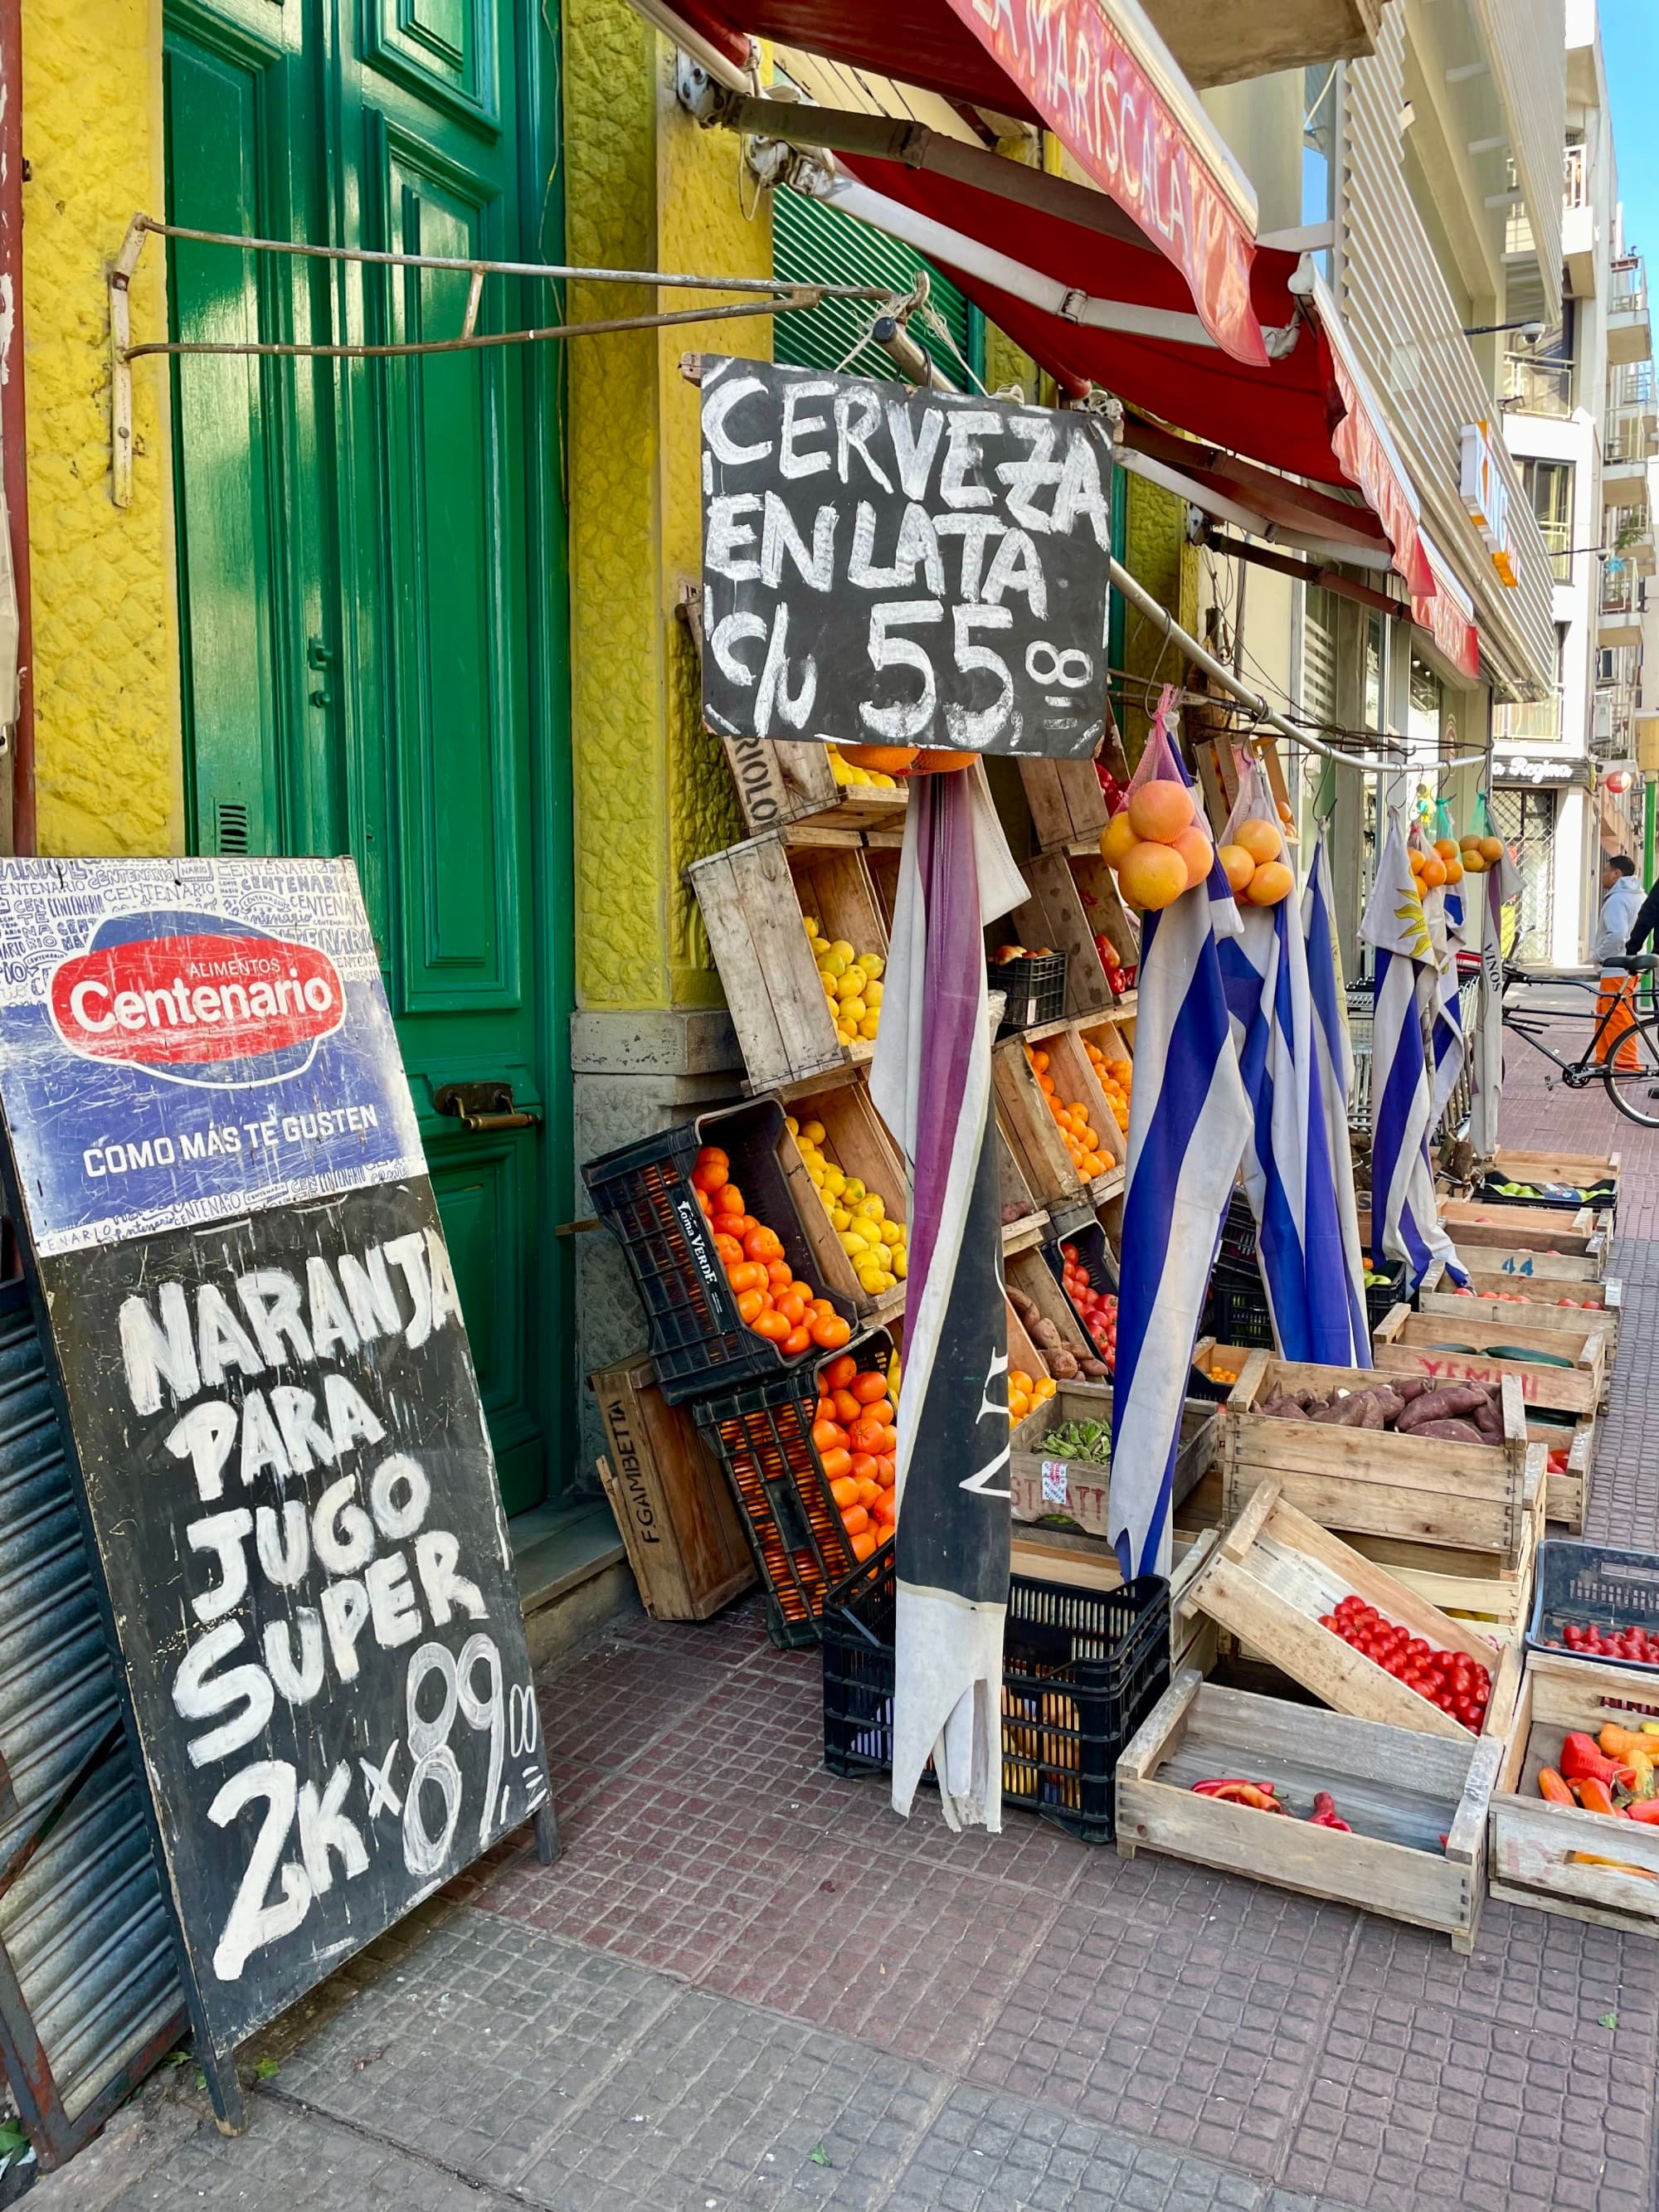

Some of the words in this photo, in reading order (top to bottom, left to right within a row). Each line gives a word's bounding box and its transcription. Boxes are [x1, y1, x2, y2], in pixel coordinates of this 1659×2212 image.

[1025, 0, 1190, 259] MARISCALA
[701, 377, 1110, 552] CERVEZA
[704, 489, 839, 593] EN
[847, 499, 1048, 620] LATA
[1509, 756, 1574, 784] Regina
[71, 968, 333, 1033] Centenario
[189, 958, 281, 979] ALIMENTOS
[1484, 943, 1501, 992] VINOS
[83, 1137, 176, 1179] COMO
[180, 1122, 241, 1160] MÁS
[243, 1122, 280, 1149] TE
[282, 1104, 379, 1144] GUSTEN
[118, 1227, 465, 1417] NARANJA
[691, 1234, 718, 1285] VERDE
[1501, 1257, 1534, 1276] 44
[164, 1373, 387, 1501] PARA
[187, 1452, 431, 1621] JUGO
[173, 1530, 490, 1770] SUPER
[207, 1757, 371, 1981] 2K
